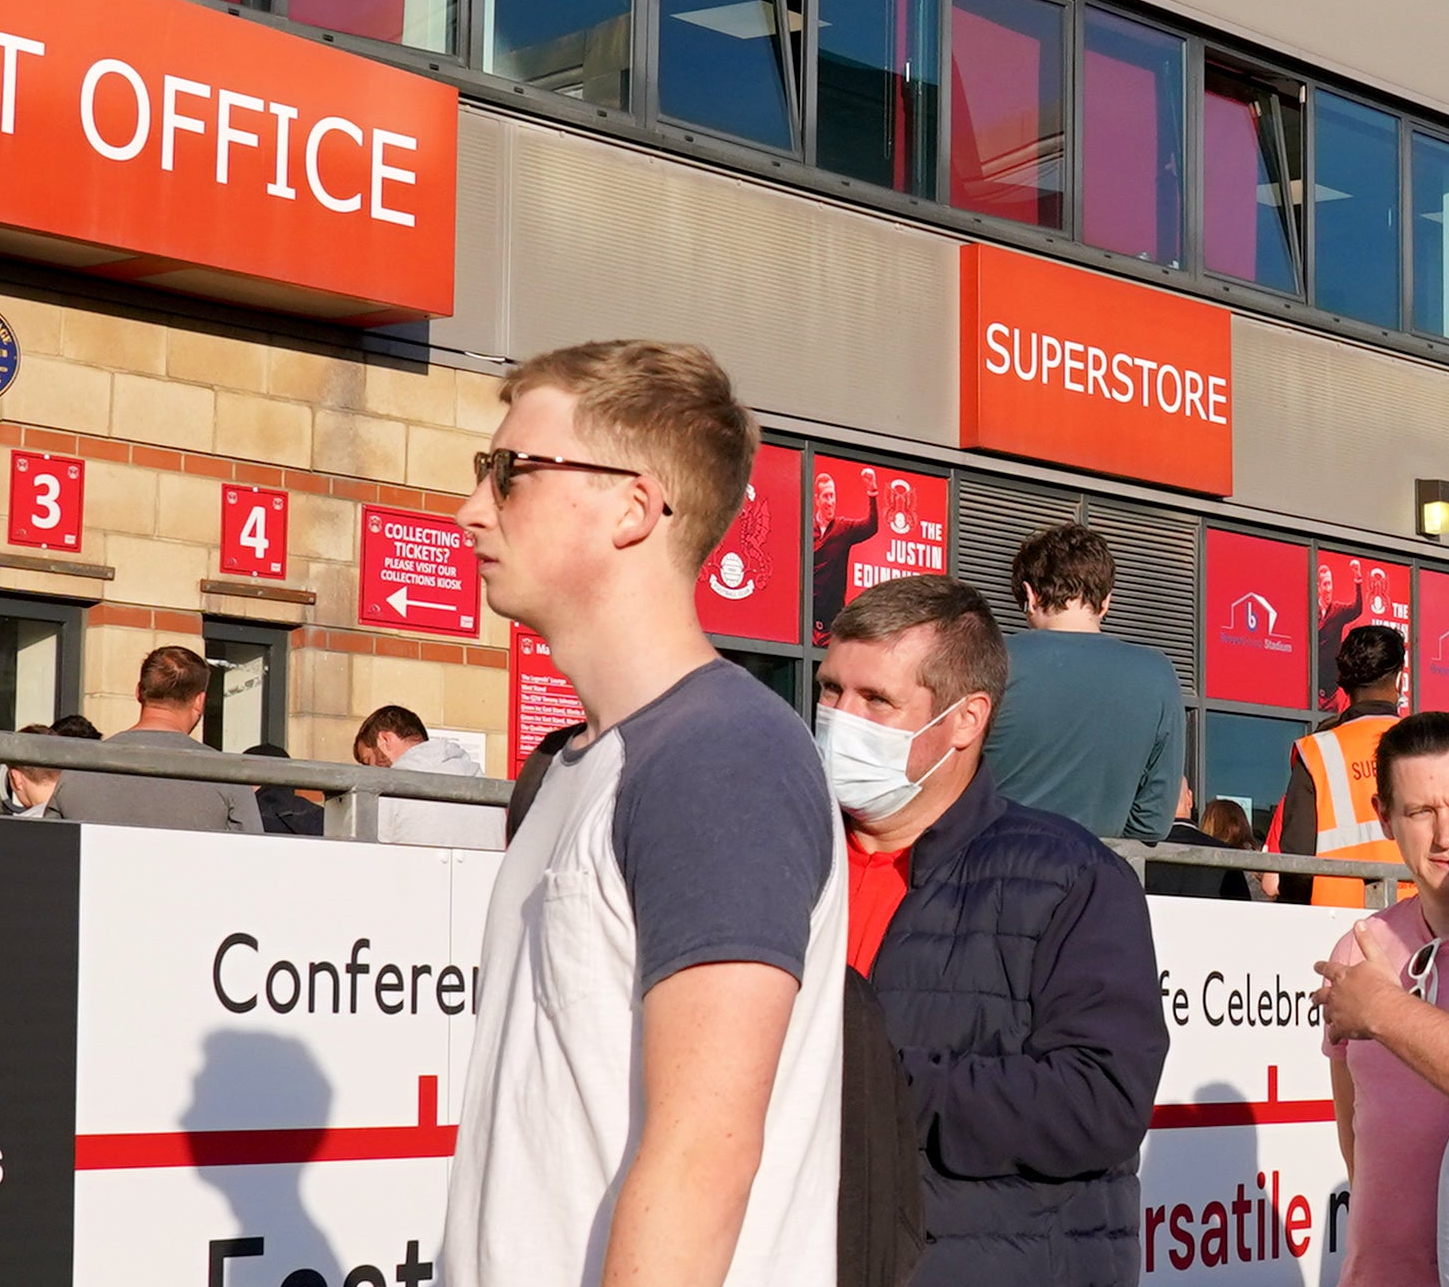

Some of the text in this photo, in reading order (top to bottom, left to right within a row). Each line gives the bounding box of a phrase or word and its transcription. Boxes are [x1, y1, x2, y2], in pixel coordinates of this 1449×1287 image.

[78, 57, 418, 228] OFFICE
[985, 322, 1227, 424] SUPERSTORE
[31, 473, 62, 529] 3
[239, 506, 269, 560] 4
[384, 523, 460, 548] COLLECTING
[920, 521, 942, 541] THE
[394, 541, 450, 563] TICKETS?
[886, 539, 942, 569] JUSTIN
[384, 557, 456, 577] PLEASE VISIT OUR
[380, 570, 462, 590] COLLECTIONS KIOSK
[1392, 602, 1409, 619] THE
